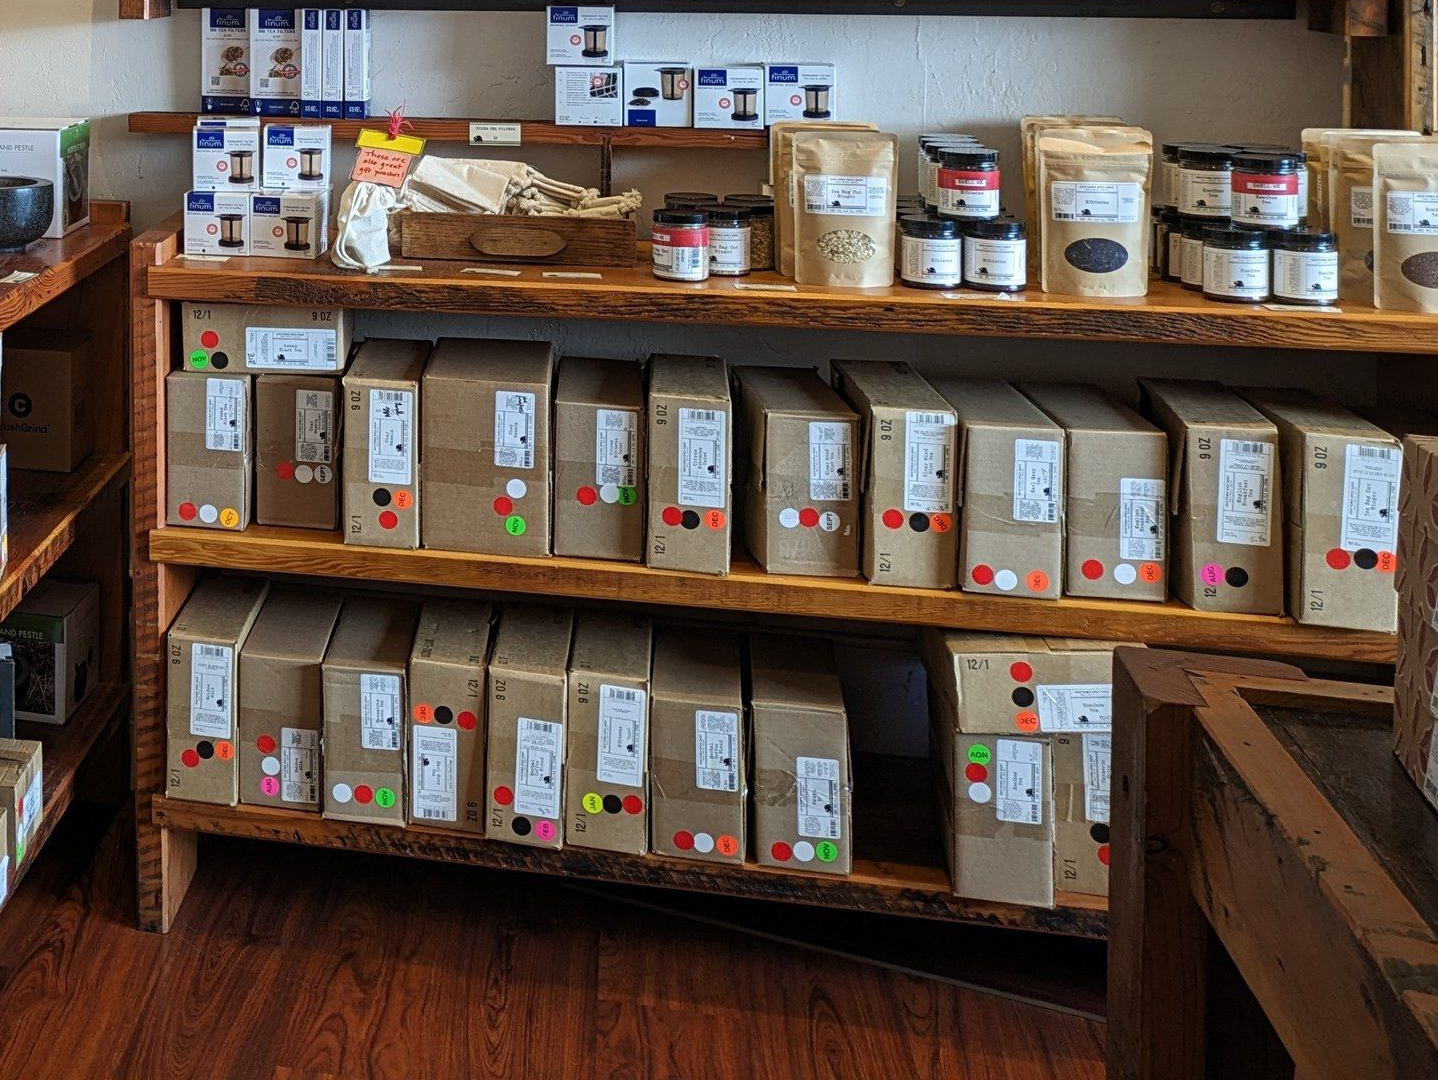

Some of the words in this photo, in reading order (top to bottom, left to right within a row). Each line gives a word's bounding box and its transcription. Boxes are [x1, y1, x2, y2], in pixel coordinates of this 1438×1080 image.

[363, 158, 378, 168] also
[379, 162, 403, 173] great
[365, 150, 391, 162] These
[392, 156, 406, 165] are
[359, 166, 373, 177] gift
[193, 310, 212, 320] 12/1
[312, 311, 317, 321] 9
[320, 311, 332, 321] OZ
[190, 355, 207, 364] NOV
[319, 466, 327, 483] SEPT
[398, 491, 406, 507] DEC
[224, 510, 235, 525] OCT
[352, 515, 361, 534] 12/1
[510, 518, 521, 533] NOV
[711, 512, 719, 528] DEC
[825, 512, 834, 530] SEPT
[655, 535, 666, 554] 12/1
[880, 553, 890, 574] 12/1
[1033, 572, 1042, 590] DEC
[1146, 564, 1155, 581] DEC
[1208, 565, 1217, 583] AUG
[1311, 590, 1323, 612] 12/1
[0, 628, 17, 637] AND
[18, 629, 44, 640] PESTLE
[966, 659, 989, 670] 12/1
[468, 680, 478, 698] 12/1
[171, 769, 180, 787] 12/1
[381, 790, 389, 805] NOV
[493, 809, 503, 827] 12/1
[576, 813, 586, 832] 12/1
[822, 843, 831, 861] NOV
